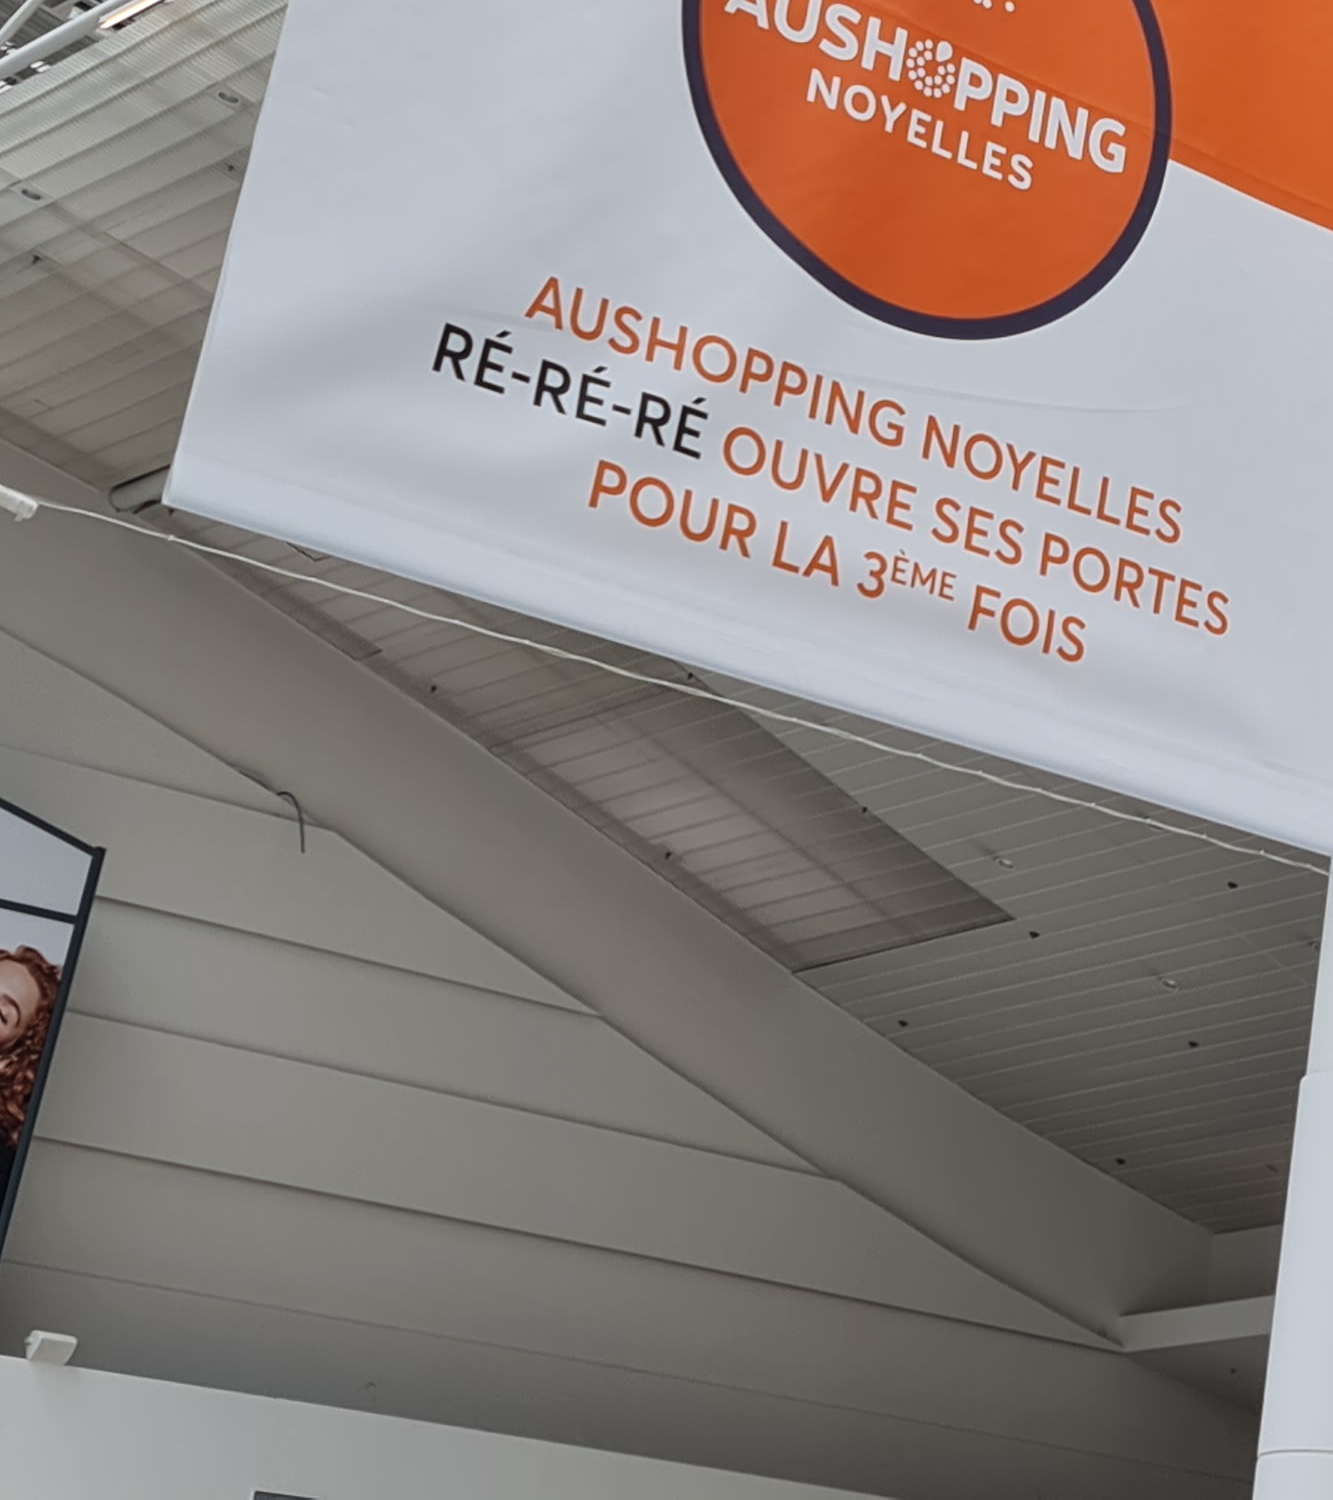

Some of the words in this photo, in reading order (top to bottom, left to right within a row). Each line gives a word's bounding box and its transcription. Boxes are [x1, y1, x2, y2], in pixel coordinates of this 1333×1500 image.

[806, 67, 1034, 190] NOYELLES
[431, 322, 710, 460] RÉ-RÉ-RÉ
[722, 425, 918, 532] OUVRE
[931, 496, 1025, 565] SES
[1038, 531, 1231, 638] PORTES
[525, 275, 907, 448] AUSHOPPING
[921, 414, 1184, 546] NOYELLES
[587, 458, 758, 559] POUR
[771, 520, 841, 588] LA
[967, 582, 1087, 665] FOIS
